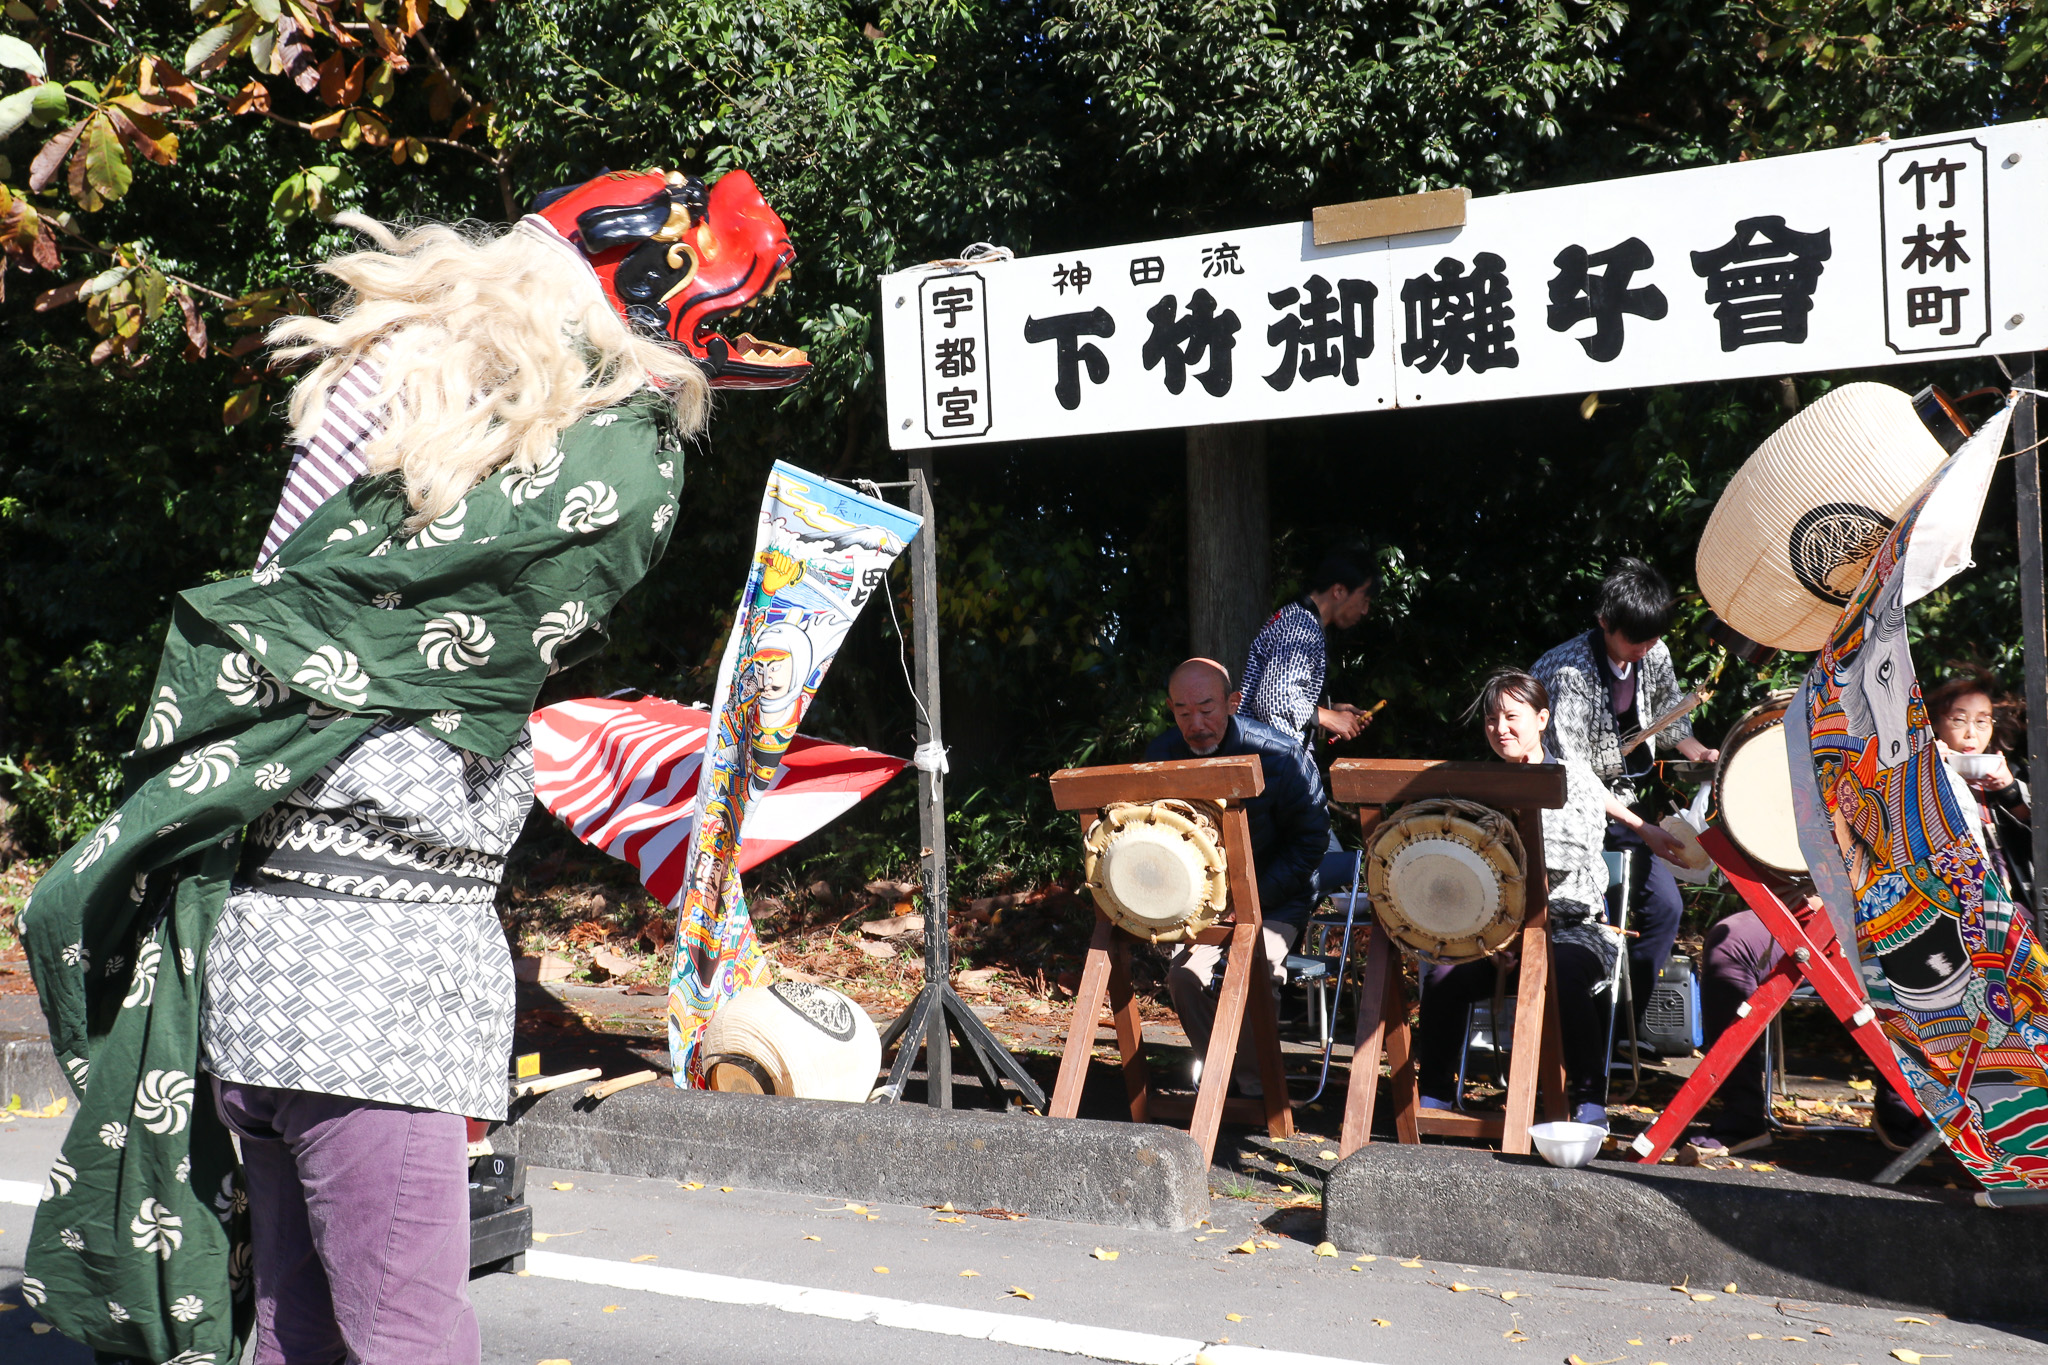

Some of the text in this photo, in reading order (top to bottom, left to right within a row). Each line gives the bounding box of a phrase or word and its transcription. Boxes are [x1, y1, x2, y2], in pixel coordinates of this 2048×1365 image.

[1023, 214, 1832, 411] 下竹御囃子會
[1053, 242, 1245, 296] 神田流
[1898, 157, 1971, 336] 竹林町
[932, 286, 978, 428] 宇都宮
